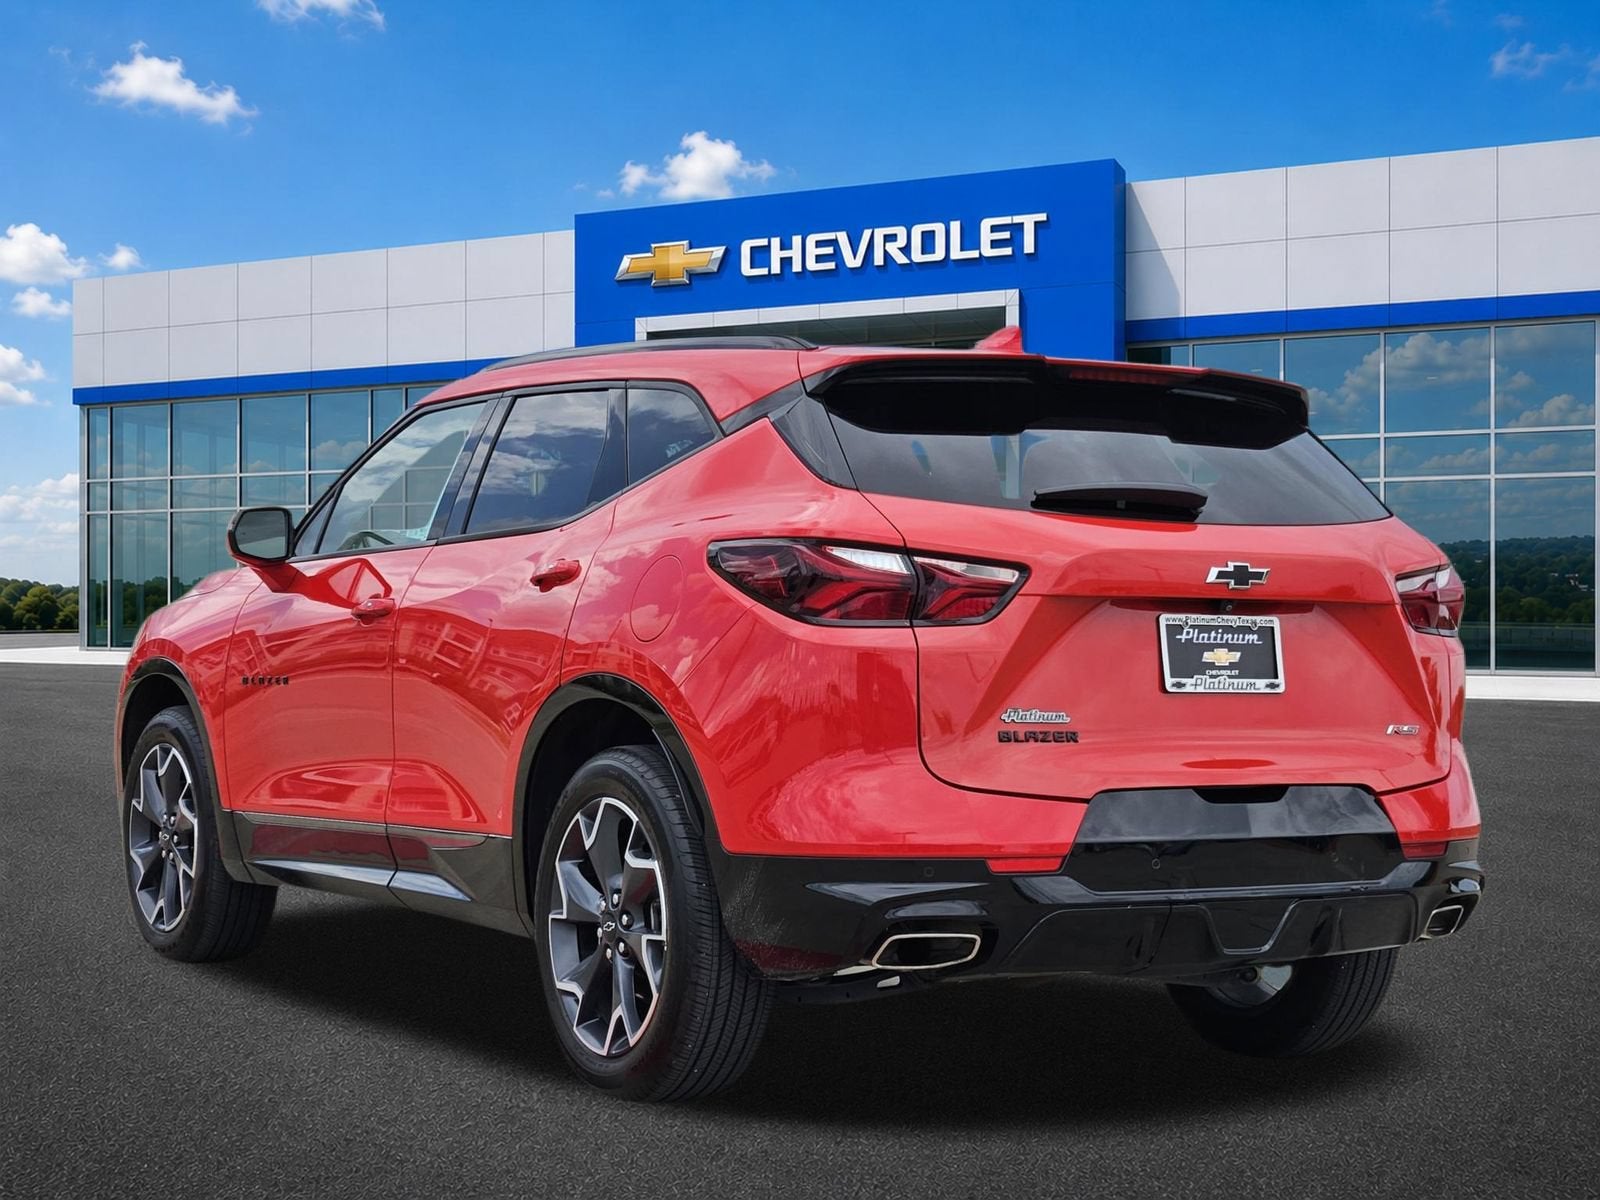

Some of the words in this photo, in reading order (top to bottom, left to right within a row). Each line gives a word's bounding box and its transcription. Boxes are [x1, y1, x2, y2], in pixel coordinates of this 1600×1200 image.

[740, 213, 1048, 277] CHEVROLET
[1176, 628, 1263, 644] Platinum
[242, 676, 288, 686] BLAZER
[1190, 677, 1261, 691] Platinum
[1001, 709, 1071, 723] Platinum
[998, 731, 1079, 743] BLAZER
